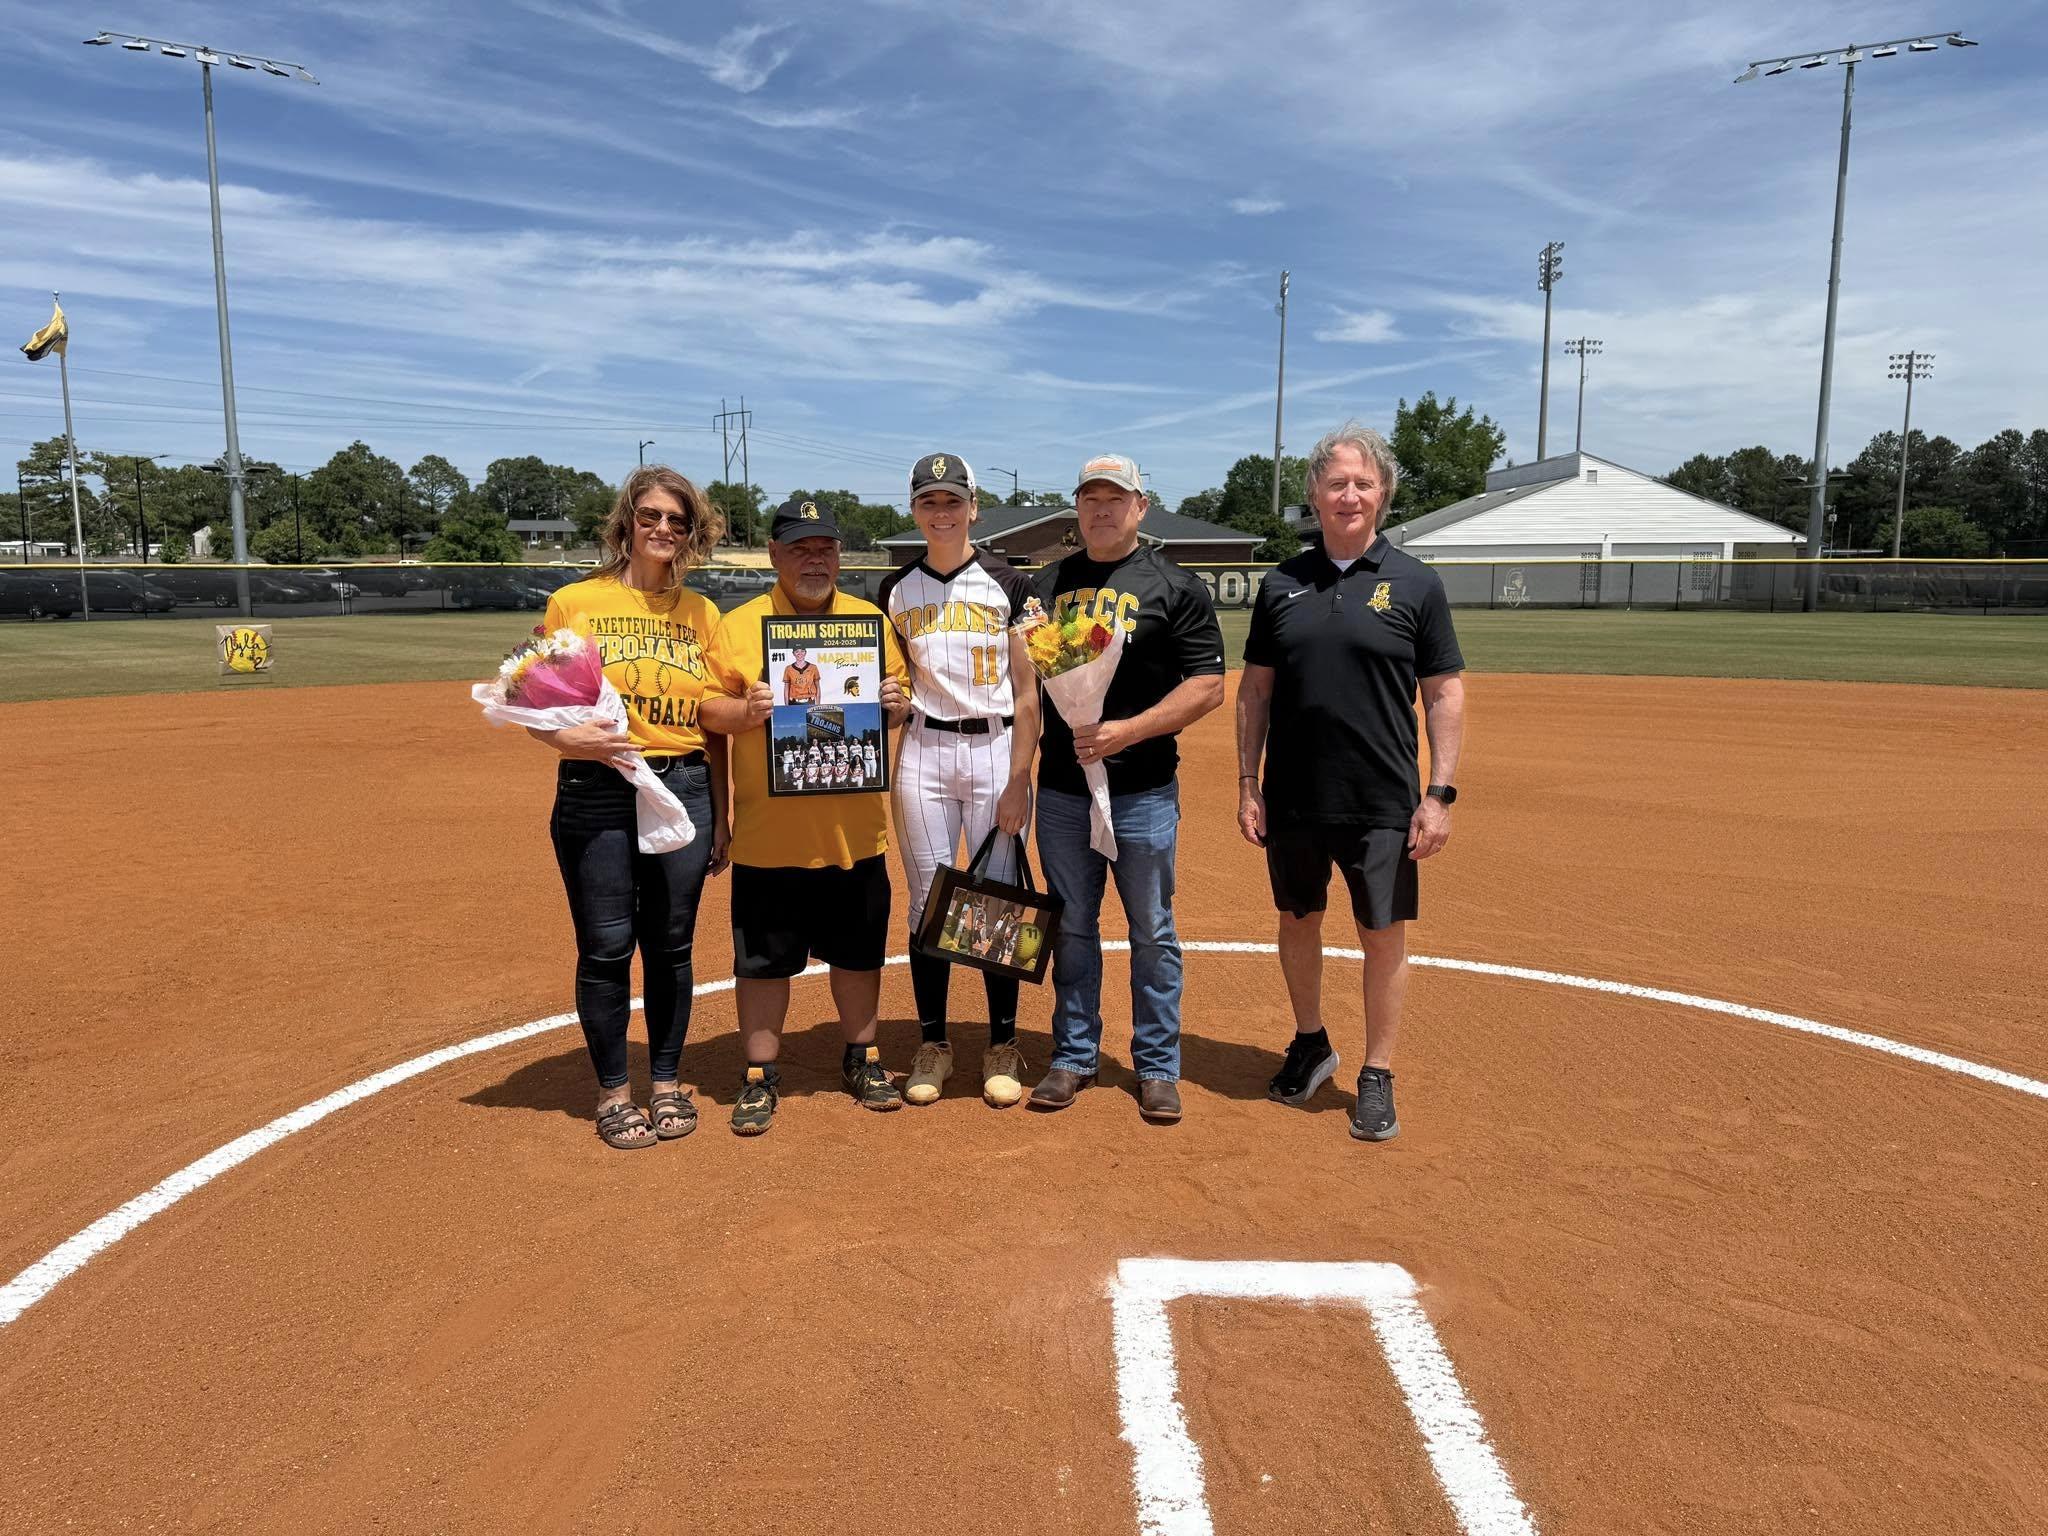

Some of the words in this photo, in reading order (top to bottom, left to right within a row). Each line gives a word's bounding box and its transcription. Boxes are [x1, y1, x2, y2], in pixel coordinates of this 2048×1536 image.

[894, 601, 1001, 640] TROJANS
[770, 624, 816, 640] TROJAN
[819, 622, 876, 639] SOFTBALL
[823, 639, 857, 647] 2024-2025
[771, 652, 786, 663] #11
[817, 652, 875, 664] MADELINE
[971, 645, 998, 686] 11
[810, 714, 841, 734] TROJANS
[1026, 928, 1037, 939] 11
